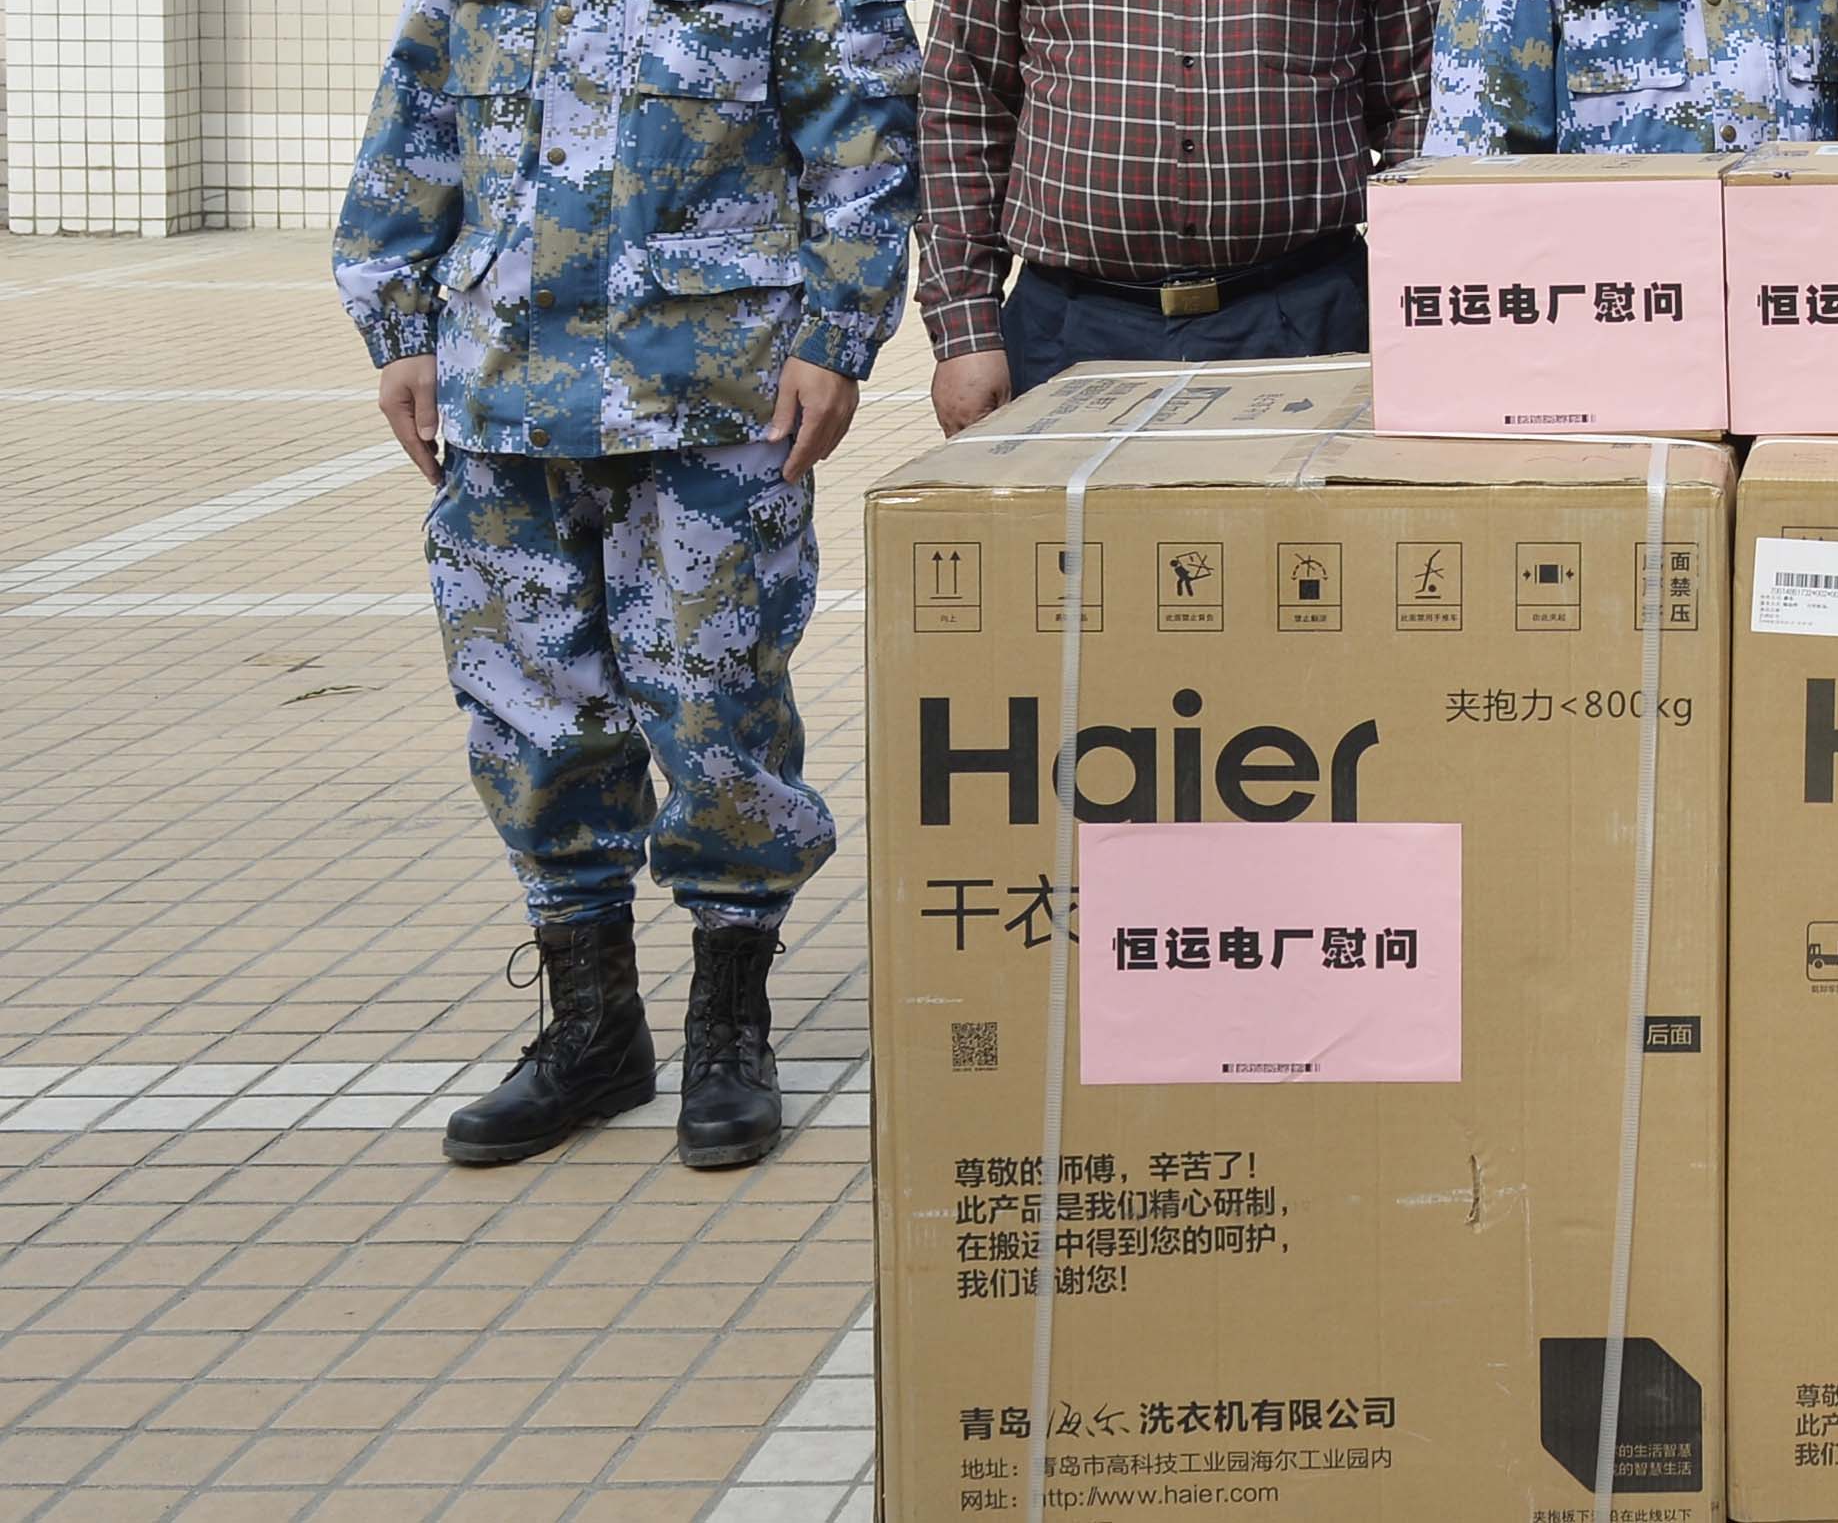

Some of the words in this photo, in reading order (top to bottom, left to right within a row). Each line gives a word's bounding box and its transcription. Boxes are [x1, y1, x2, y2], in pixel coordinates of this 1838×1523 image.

[1400, 280, 1685, 327] 恒运电厂慰问
[920, 687, 1379, 825] Haier
[1113, 926, 1420, 973] 恒运电厂慰问
[1646, 1023, 1693, 1046] 后面
